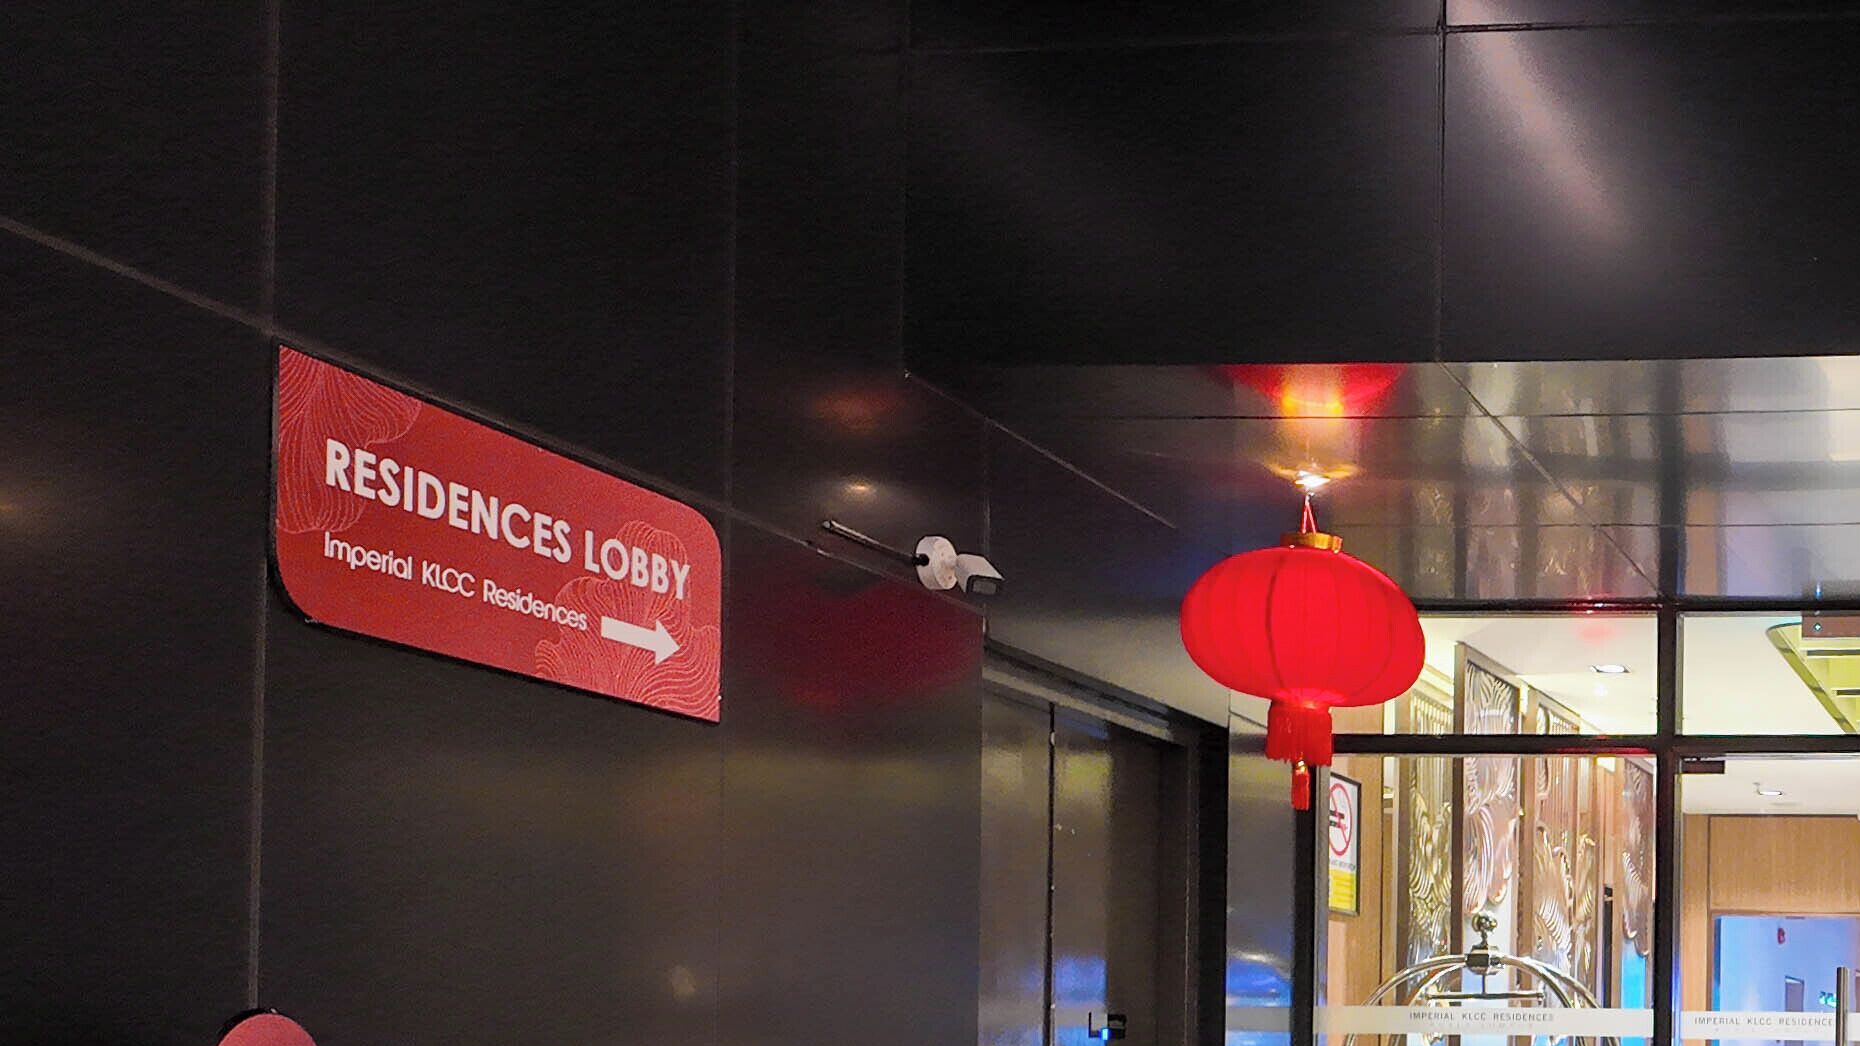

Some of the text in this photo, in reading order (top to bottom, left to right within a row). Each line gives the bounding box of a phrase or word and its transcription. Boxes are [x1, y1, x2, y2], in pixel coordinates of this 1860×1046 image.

[323, 532, 588, 632] Imperial KLCC Residences
[325, 438, 691, 600] RESIDENCES LOBBY
